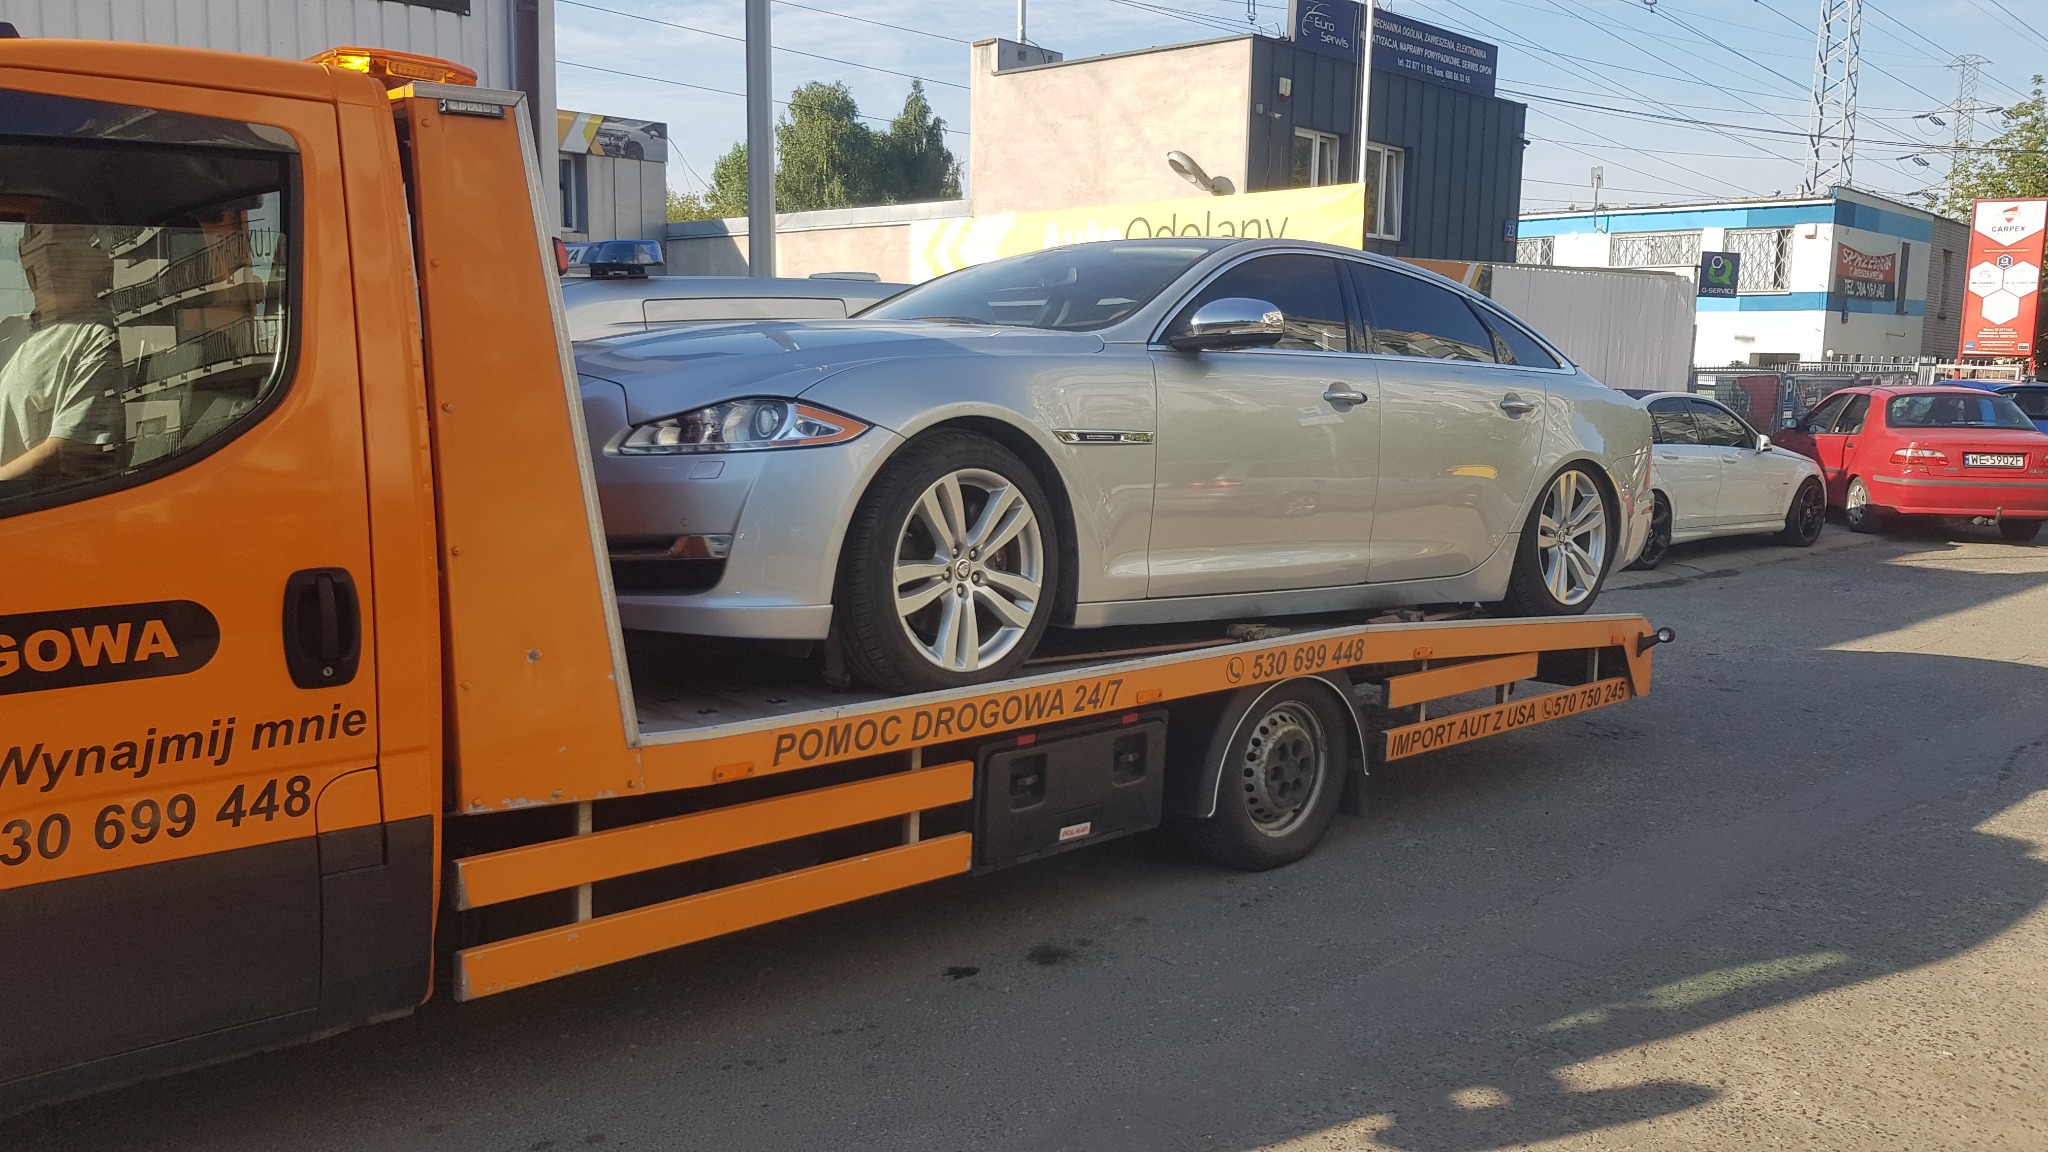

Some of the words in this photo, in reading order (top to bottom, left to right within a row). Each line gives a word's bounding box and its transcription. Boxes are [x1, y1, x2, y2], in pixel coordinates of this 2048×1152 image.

[1314, 17, 1335, 32] Euro
[1321, 31, 1349, 48] Serwis
[1506, 224, 1515, 237] 23
[1971, 455, 1986, 465] WE
[1990, 455, 2021, 465] 5902F
[1251, 650, 1288, 680] 530
[1293, 643, 1327, 672] 699
[1332, 638, 1365, 665] 448
[251, 703, 367, 751] mnie
[772, 715, 903, 767] POMOC
[911, 688, 1065, 742] DROGOWA
[1073, 679, 1124, 713] 24/7
[1390, 721, 1456, 758] IMPORT
[1457, 713, 1491, 740] AUT
[1492, 710, 1504, 731] Z
[1507, 703, 1536, 728] USA
[1553, 693, 1577, 716] 570
[1579, 687, 1601, 710] 750
[1604, 680, 1626, 704] 245
[94, 793, 197, 850] 699
[216, 775, 311, 828] 448
